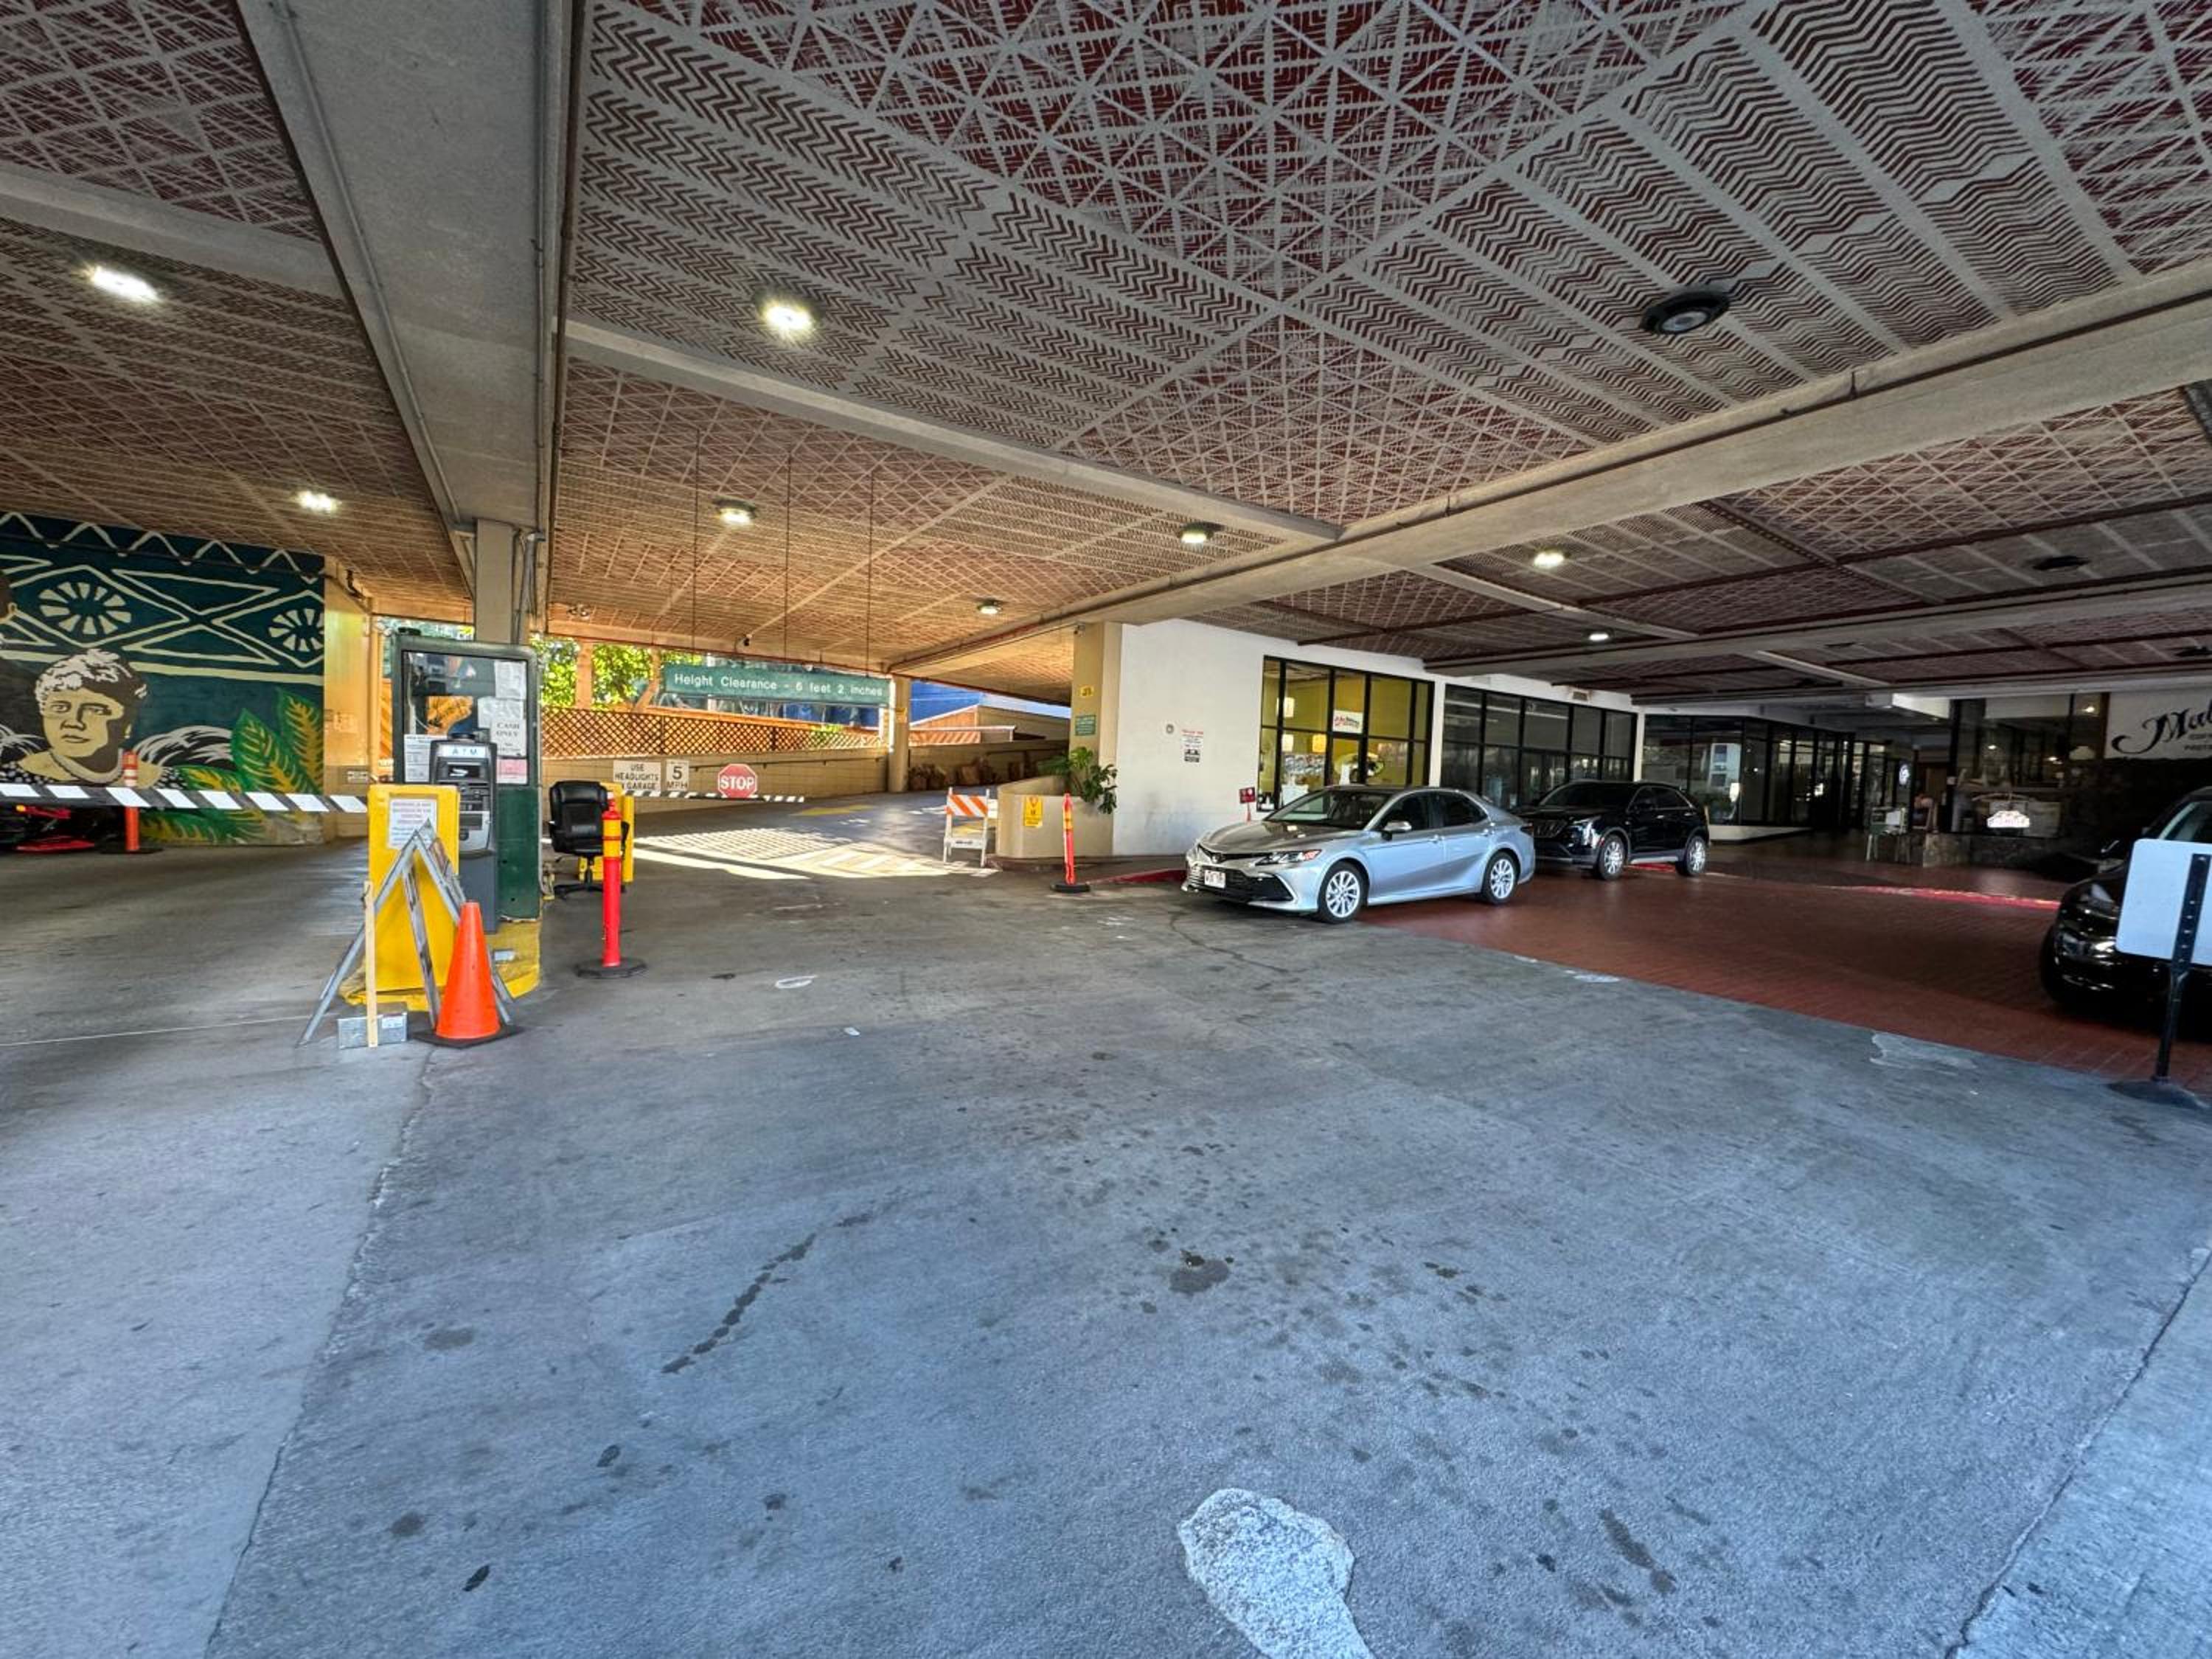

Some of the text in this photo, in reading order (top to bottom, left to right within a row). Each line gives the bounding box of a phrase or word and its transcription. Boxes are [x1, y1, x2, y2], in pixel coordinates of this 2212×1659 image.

[674, 672, 713, 687] Height
[720, 675, 778, 690] Clearance
[809, 682, 831, 694] feet
[837, 684, 844, 694] 2
[850, 684, 883, 696] inches
[497, 722, 520, 730] CASH
[630, 763, 645, 772] USE
[614, 772, 659, 782] HEADLIGHTS
[672, 765, 683, 780] 5
[626, 782, 656, 790] GARAGE
[667, 781, 689, 789] MPH
[720, 775, 754, 790] STOP
